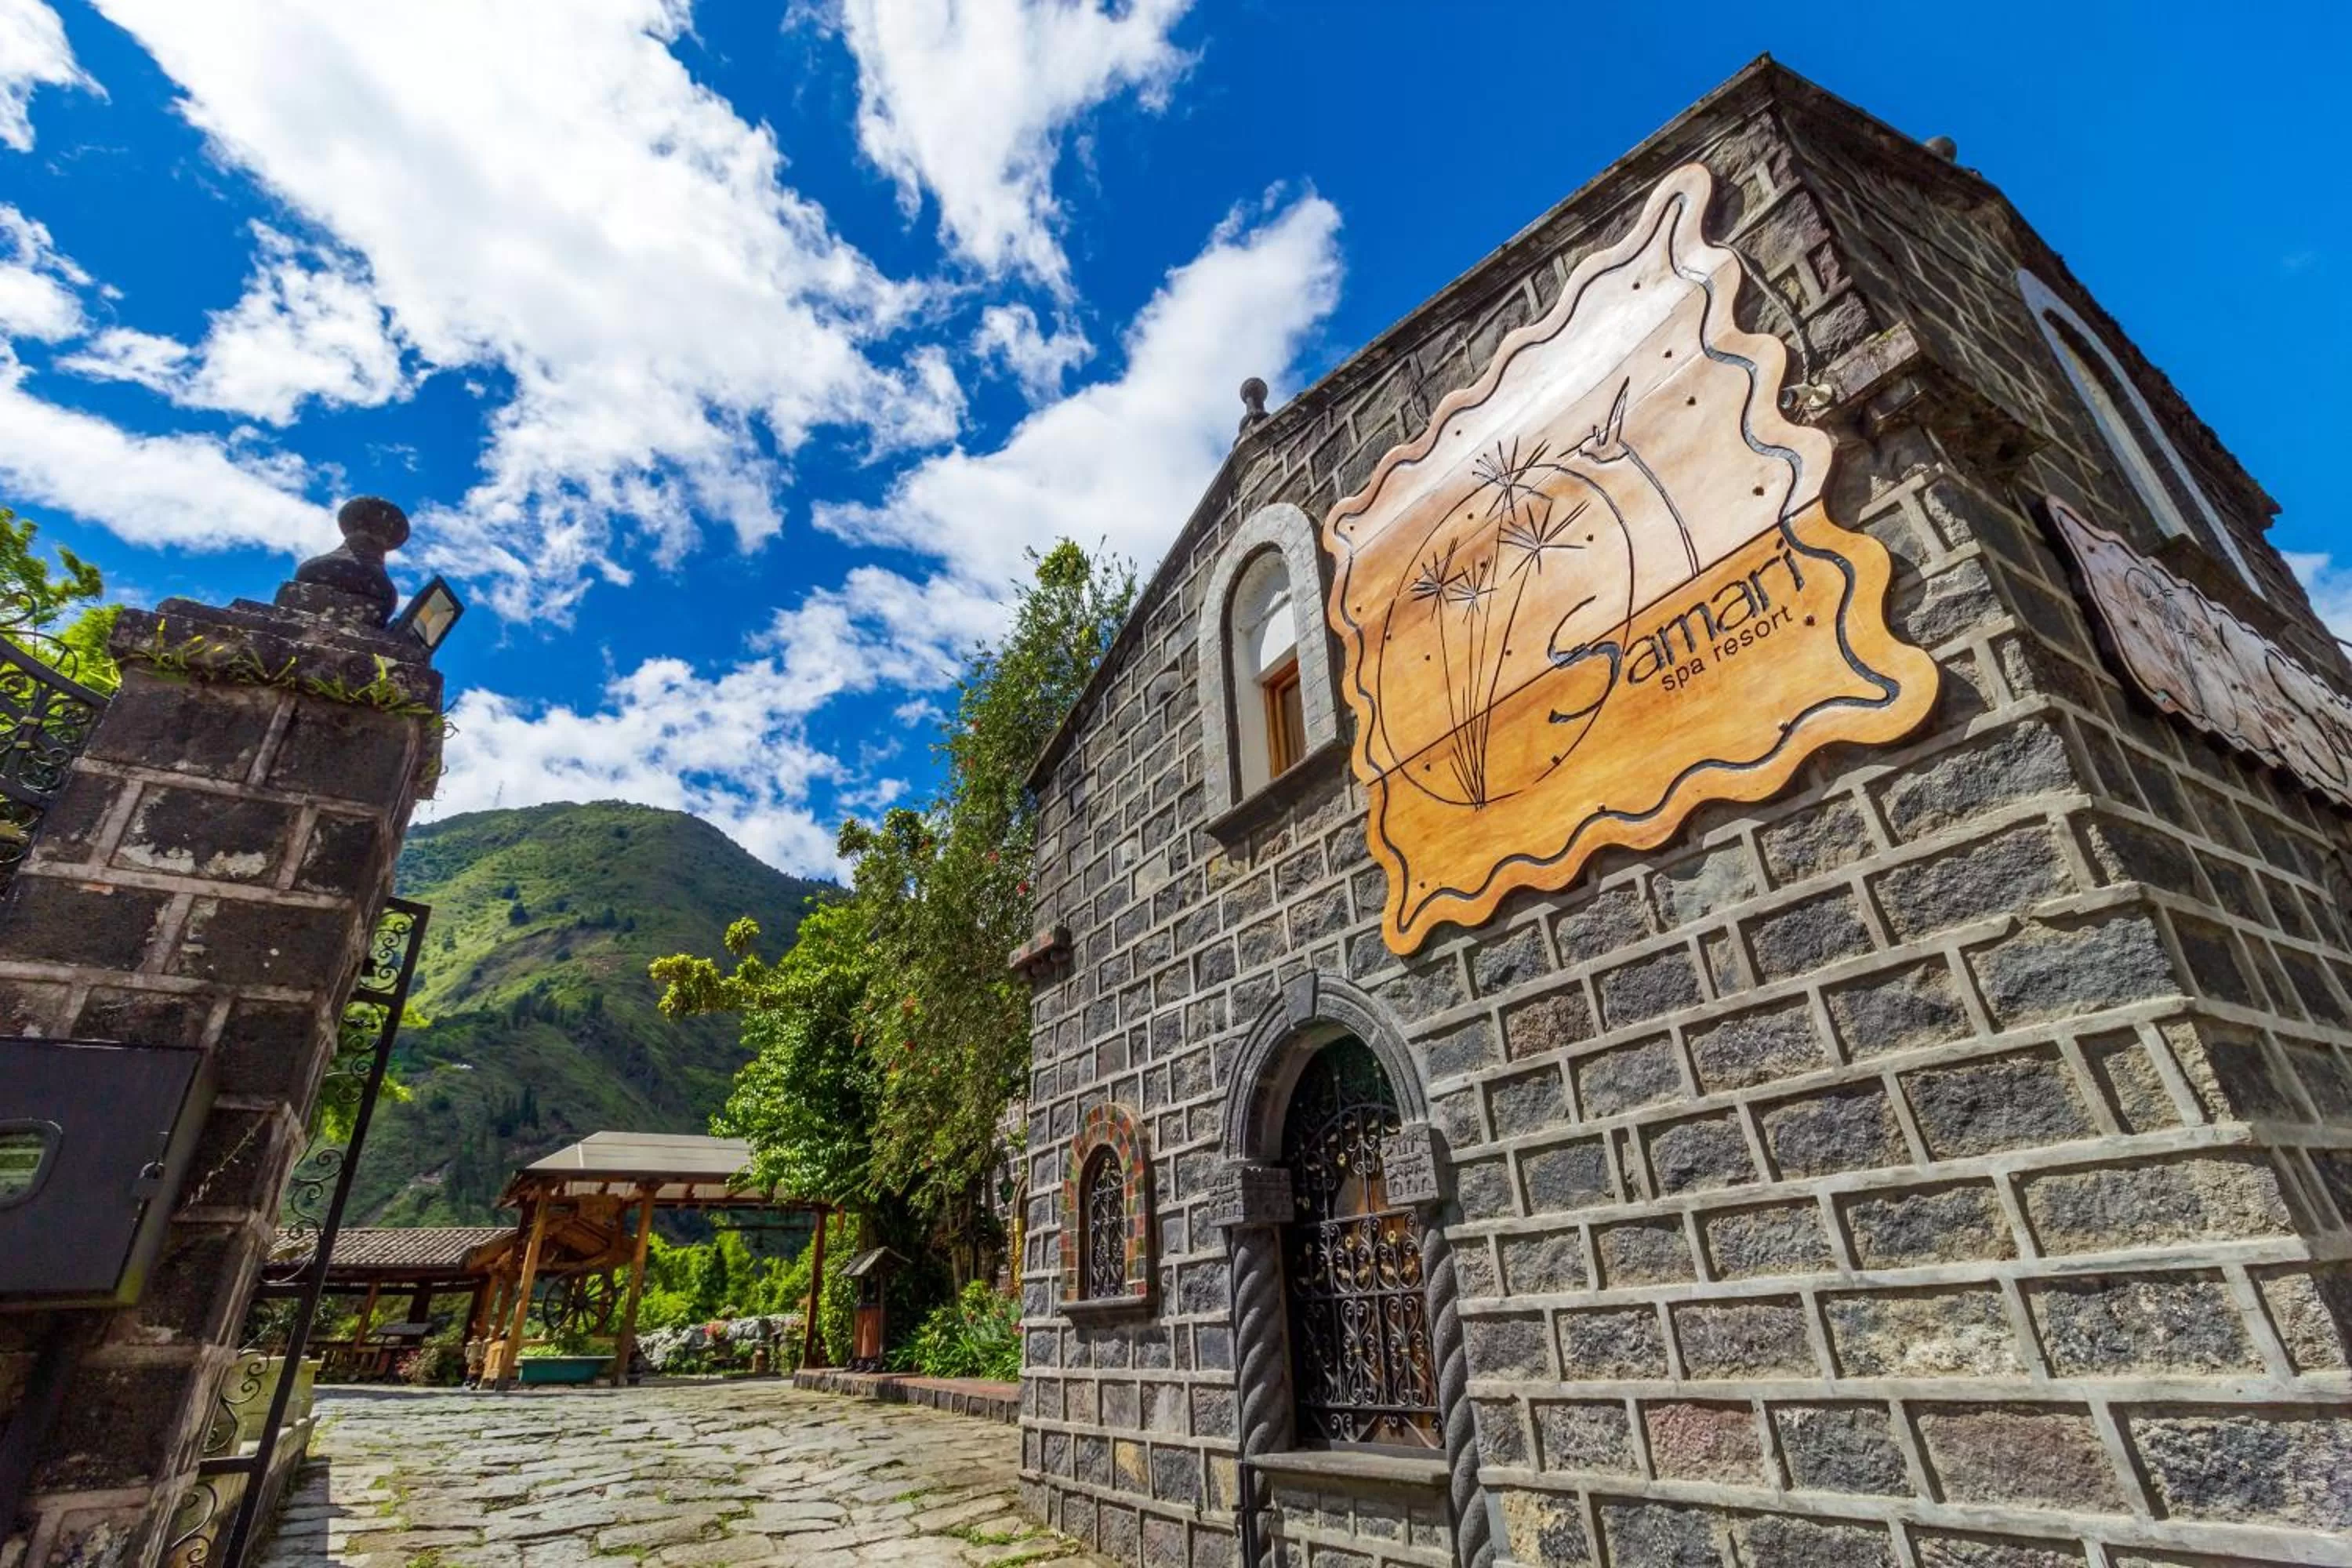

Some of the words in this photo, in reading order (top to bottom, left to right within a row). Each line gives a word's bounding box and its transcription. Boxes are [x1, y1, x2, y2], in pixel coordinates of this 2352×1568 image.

[1547, 536, 1805, 724] Samari
[1661, 657, 1707, 691] spa
[1712, 604, 1794, 662] resort
